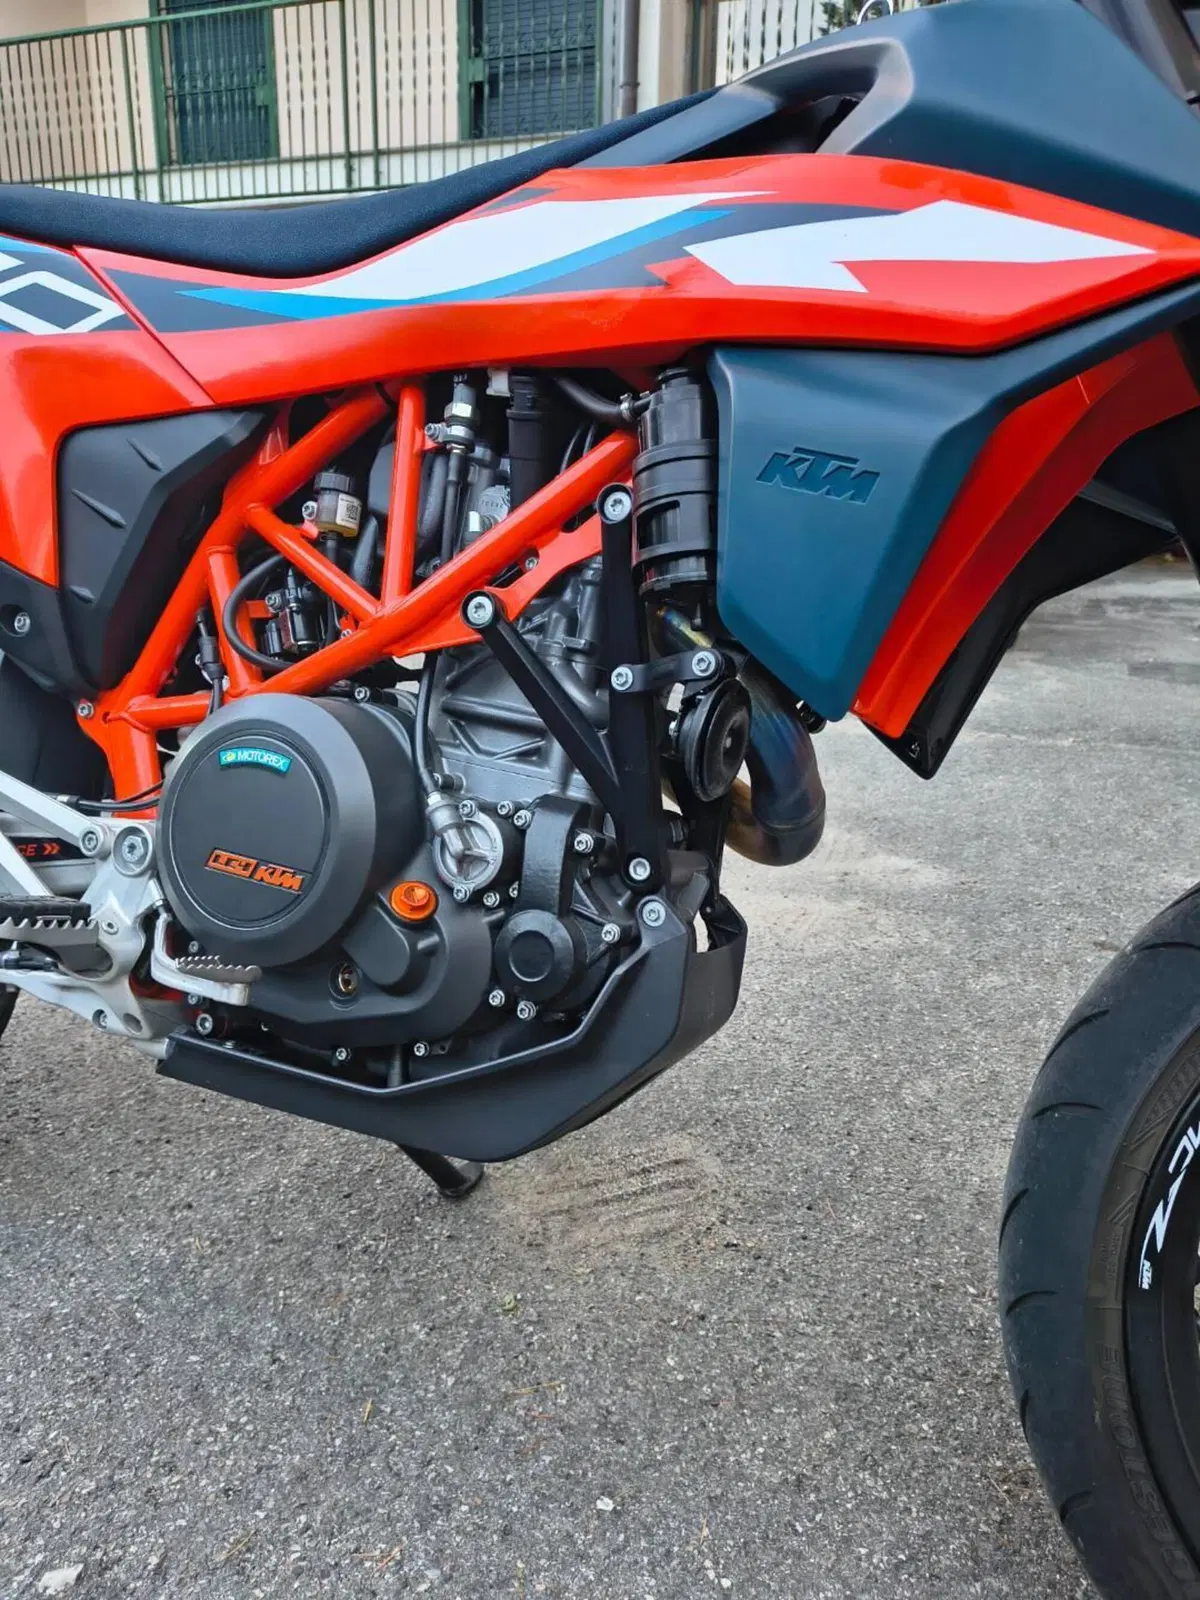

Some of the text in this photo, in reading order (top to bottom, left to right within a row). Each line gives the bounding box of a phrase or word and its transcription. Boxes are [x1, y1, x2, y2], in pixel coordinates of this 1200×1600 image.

[0, 252, 126, 335] 0
[756, 446, 880, 505] KTM
[237, 750, 285, 767] MOTOREX
[254, 864, 303, 891] KTM
